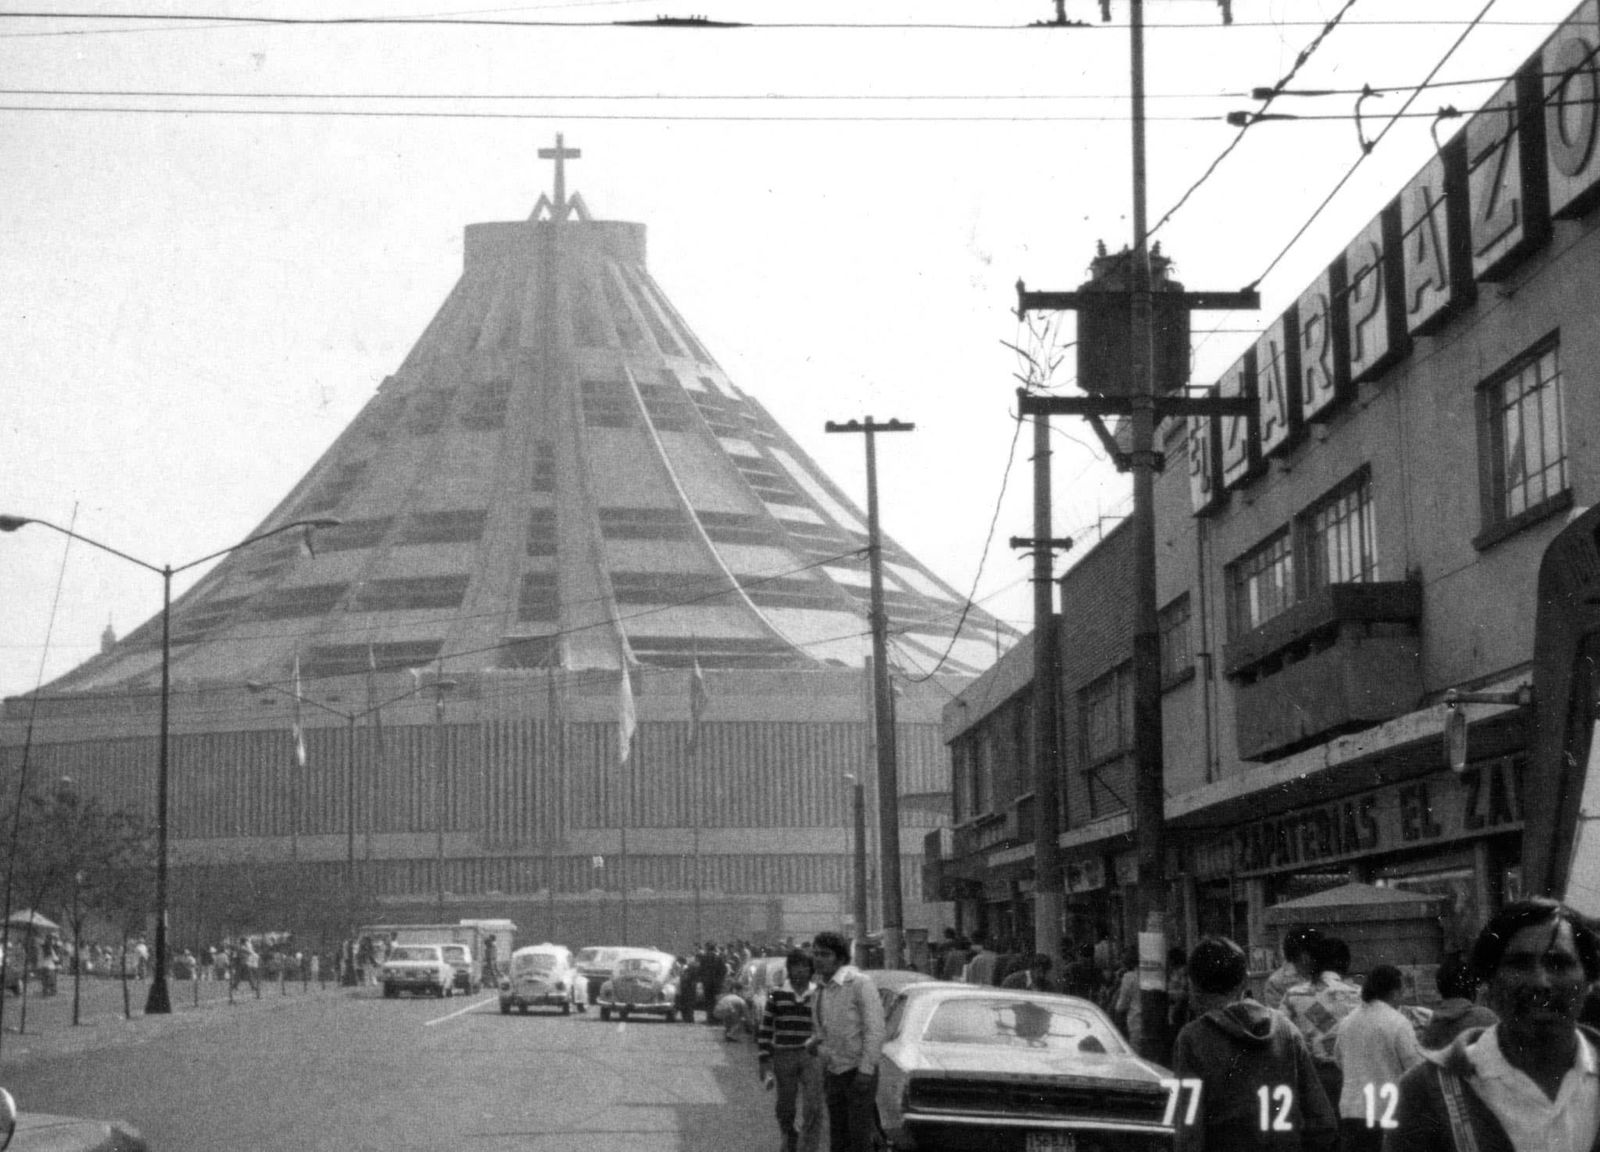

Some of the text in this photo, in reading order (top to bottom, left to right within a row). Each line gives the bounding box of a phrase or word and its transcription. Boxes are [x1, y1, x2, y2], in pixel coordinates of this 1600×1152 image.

[1220, 36, 1599, 476] ZARPAZO
[1233, 794, 1377, 873] ZAPATERIAS
[1399, 783, 1441, 842] EL
